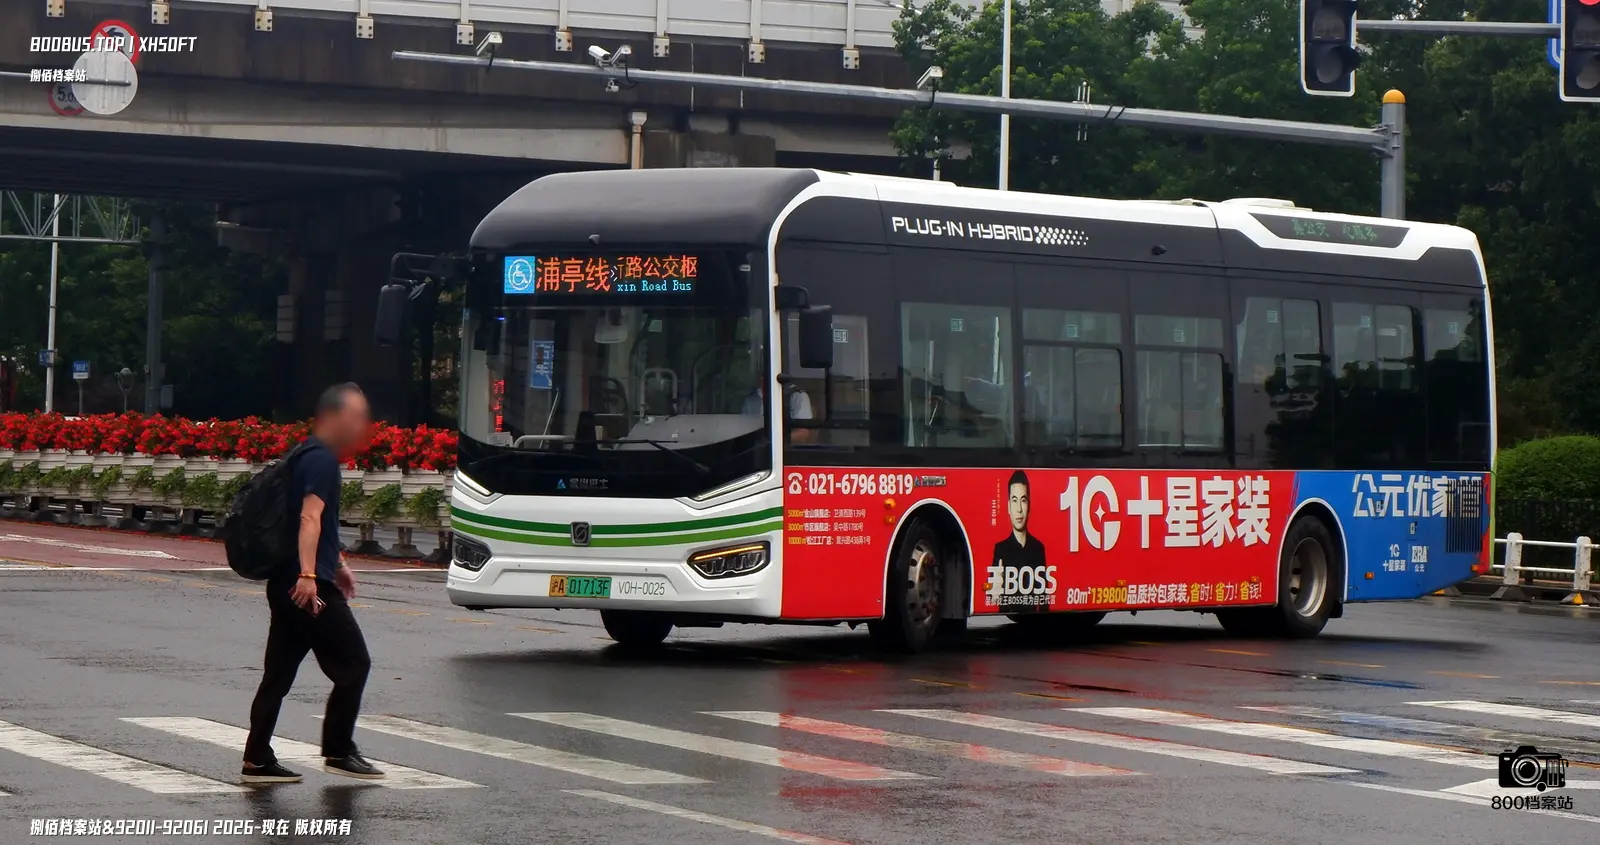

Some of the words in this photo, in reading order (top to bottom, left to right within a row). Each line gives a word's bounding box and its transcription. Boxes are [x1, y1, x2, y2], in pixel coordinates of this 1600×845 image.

[892, 216, 964, 238] PLUG-IN
[968, 222, 1033, 242] HYBRID
[536, 256, 610, 292] 浦亭线
[642, 280, 668, 291] Road
[672, 280, 692, 291] Bus
[879, 474, 914, 495] 8819
[1127, 475, 1271, 549] 十星家装
[1382, 559, 1406, 571] 十星家装
